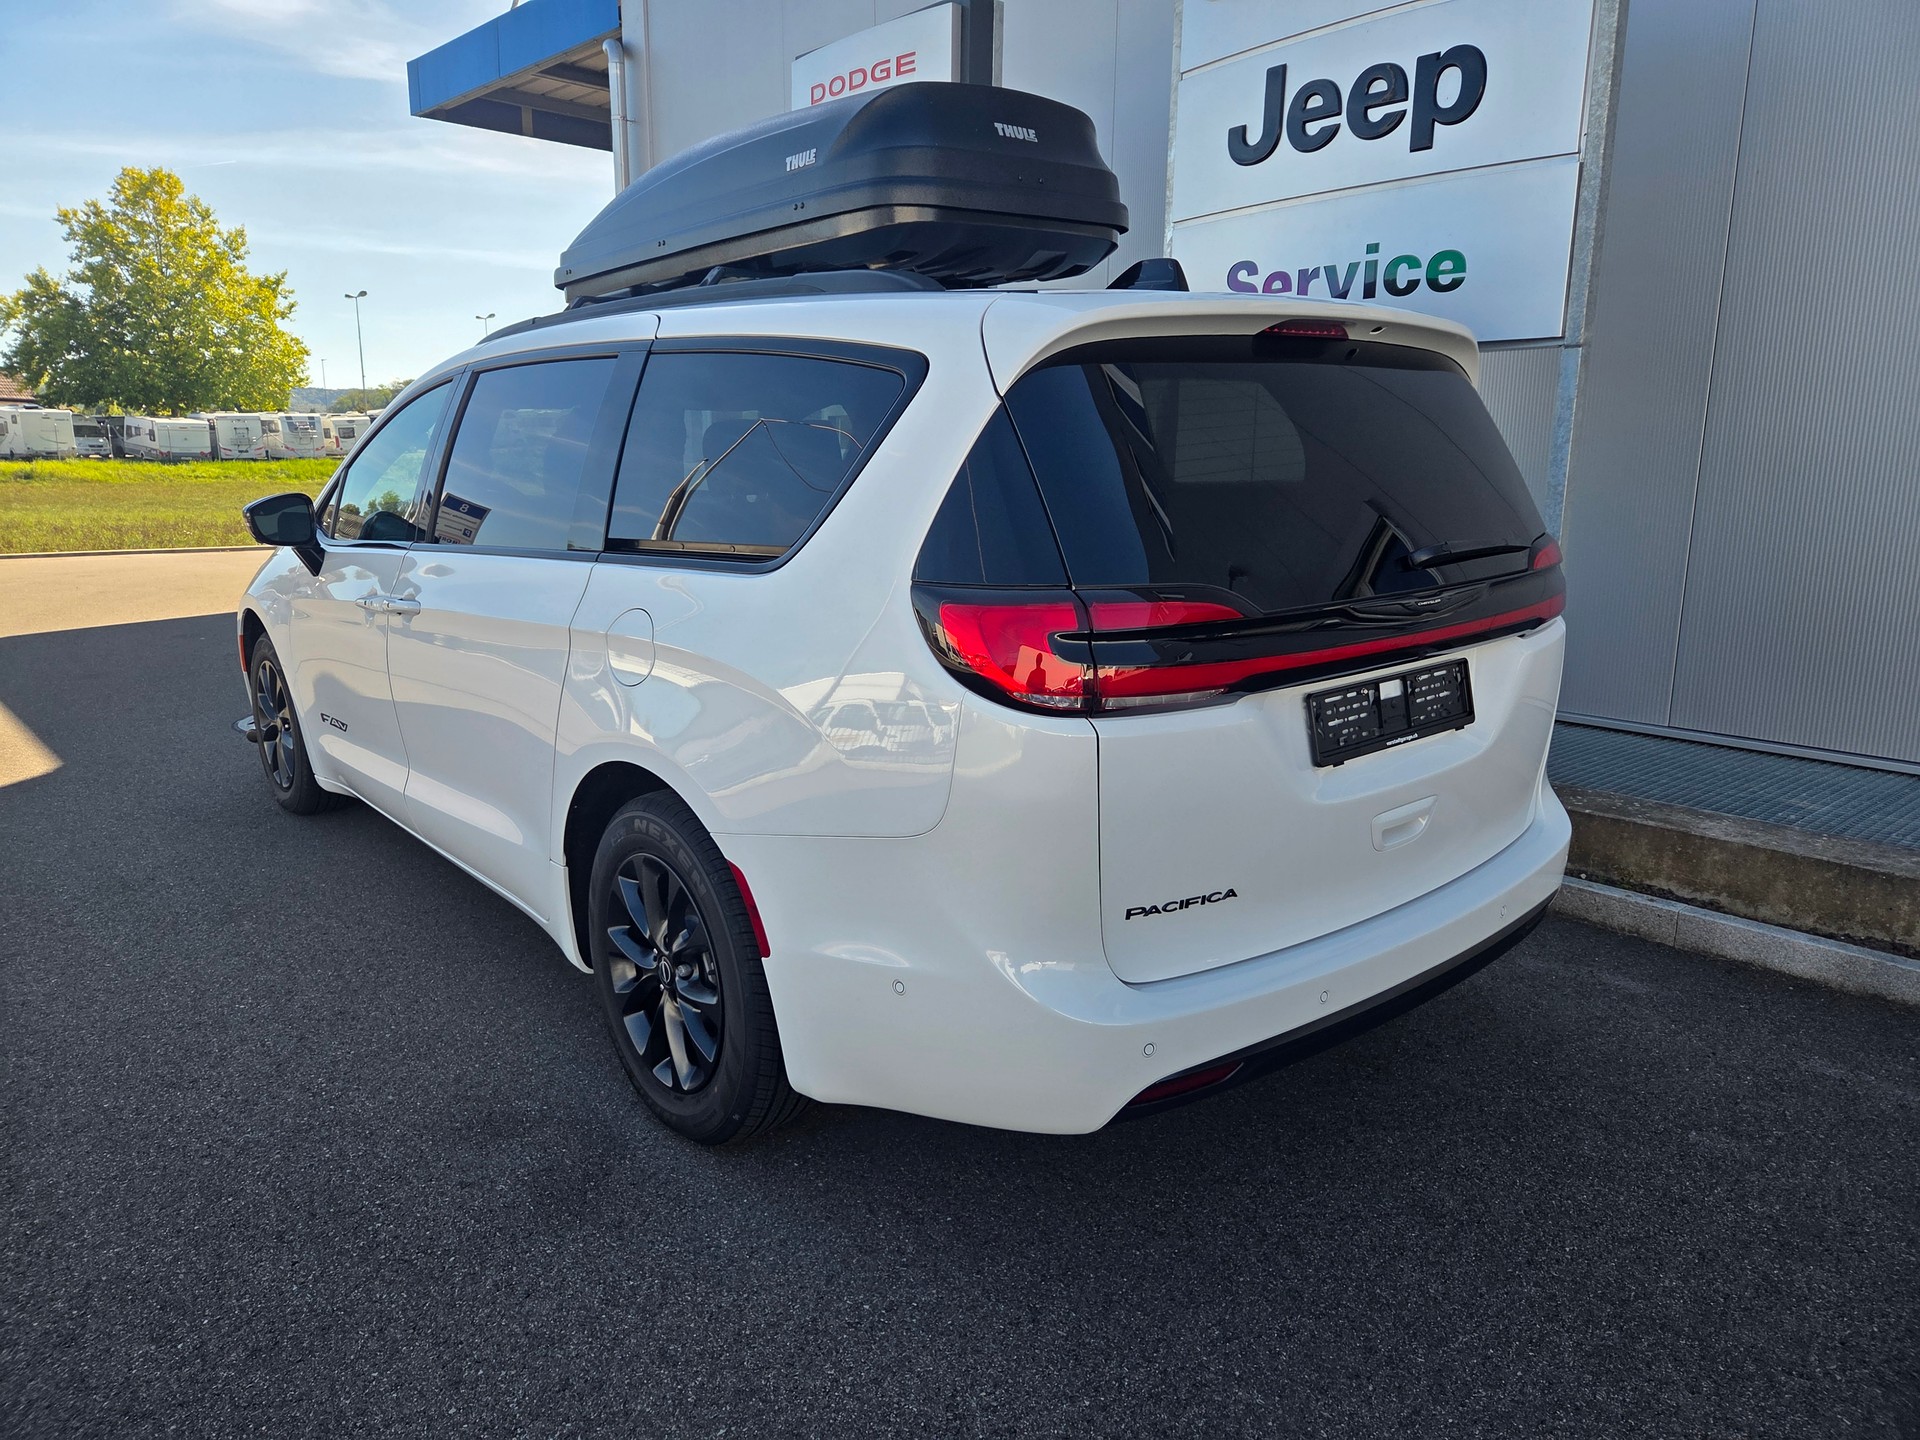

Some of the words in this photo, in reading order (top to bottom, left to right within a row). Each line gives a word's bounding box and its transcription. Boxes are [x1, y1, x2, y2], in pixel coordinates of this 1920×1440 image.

[810, 50, 917, 105] DODGE
[1227, 43, 1487, 167] Jeep
[784, 147, 817, 172] THULE
[994, 121, 1039, 143] THULE
[1226, 242, 1467, 300] Service
[633, 818, 707, 897] NEXEN
[1124, 888, 1238, 921] PACIFICA
